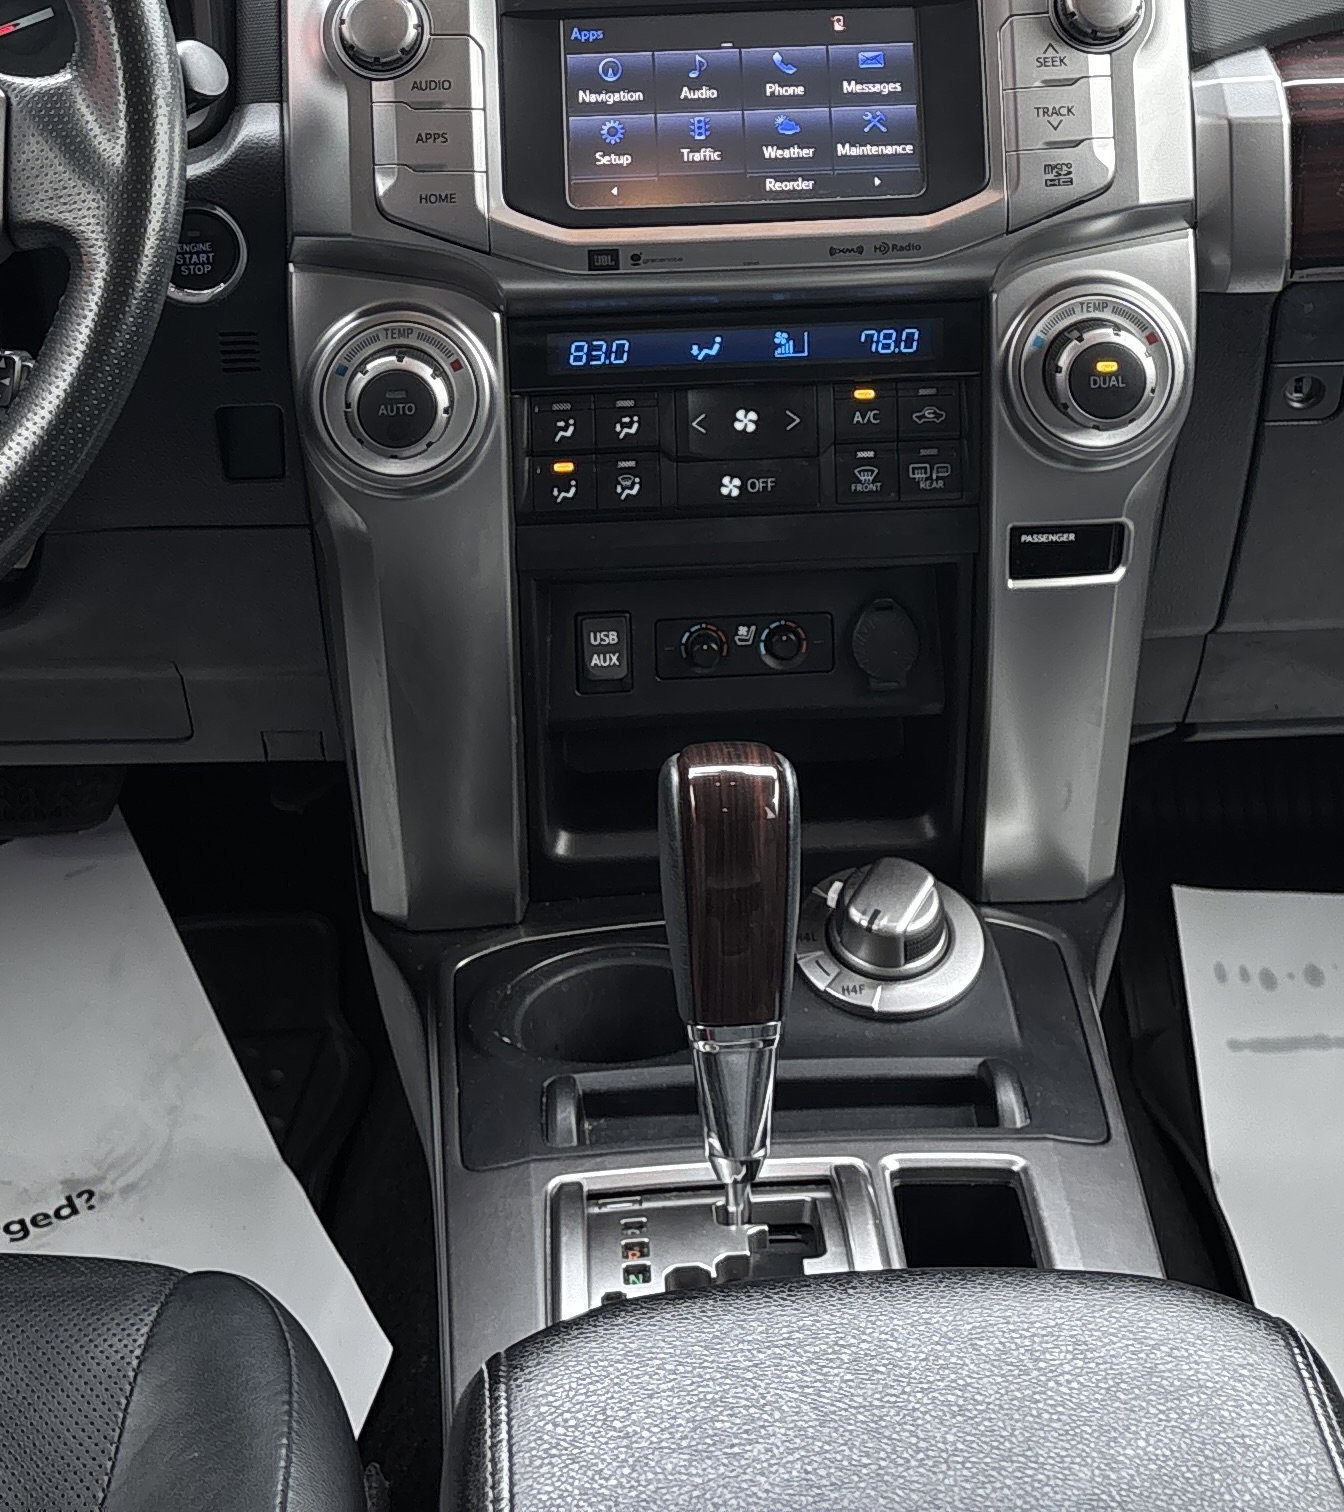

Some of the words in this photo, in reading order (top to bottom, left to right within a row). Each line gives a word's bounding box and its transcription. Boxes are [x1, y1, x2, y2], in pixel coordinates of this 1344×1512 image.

[570, 26, 604, 43] Apps
[1036, 56, 1067, 68] SEEK
[411, 79, 452, 92] AUDIO
[680, 85, 718, 100] Audio
[765, 82, 805, 97] Phone
[842, 80, 902, 95] Messages
[578, 88, 644, 104] Navigation
[1034, 105, 1076, 118] TRACK
[415, 132, 449, 145] APPS
[680, 147, 722, 163] Traffic
[763, 144, 816, 160] Weather
[837, 141, 914, 156] Maintenance
[595, 150, 632, 167] Setup
[765, 177, 815, 192] Reorder
[418, 192, 457, 204] HOME
[177, 242, 212, 252] ENGINE
[891, 242, 922, 253] Radio
[175, 253, 215, 265] START
[180, 265, 212, 276] STOP
[1079, 300, 1109, 315] TEMP
[383, 326, 415, 341] TEMP
[859, 328, 920, 354] 78.0
[568, 339, 630, 366] 83.0
[1089, 374, 1127, 389] DUAL
[378, 401, 416, 417] AUTO
[852, 409, 881, 425] A/C
[747, 478, 776, 494] OFF
[851, 481, 882, 493] FRONT
[919, 479, 945, 490] REAR
[1020, 532, 1076, 544] PASSENGER
[590, 630, 619, 646] USB
[590, 652, 620, 668] AUX
[841, 983, 865, 996] H4F
[628, 1273, 644, 1284] N
